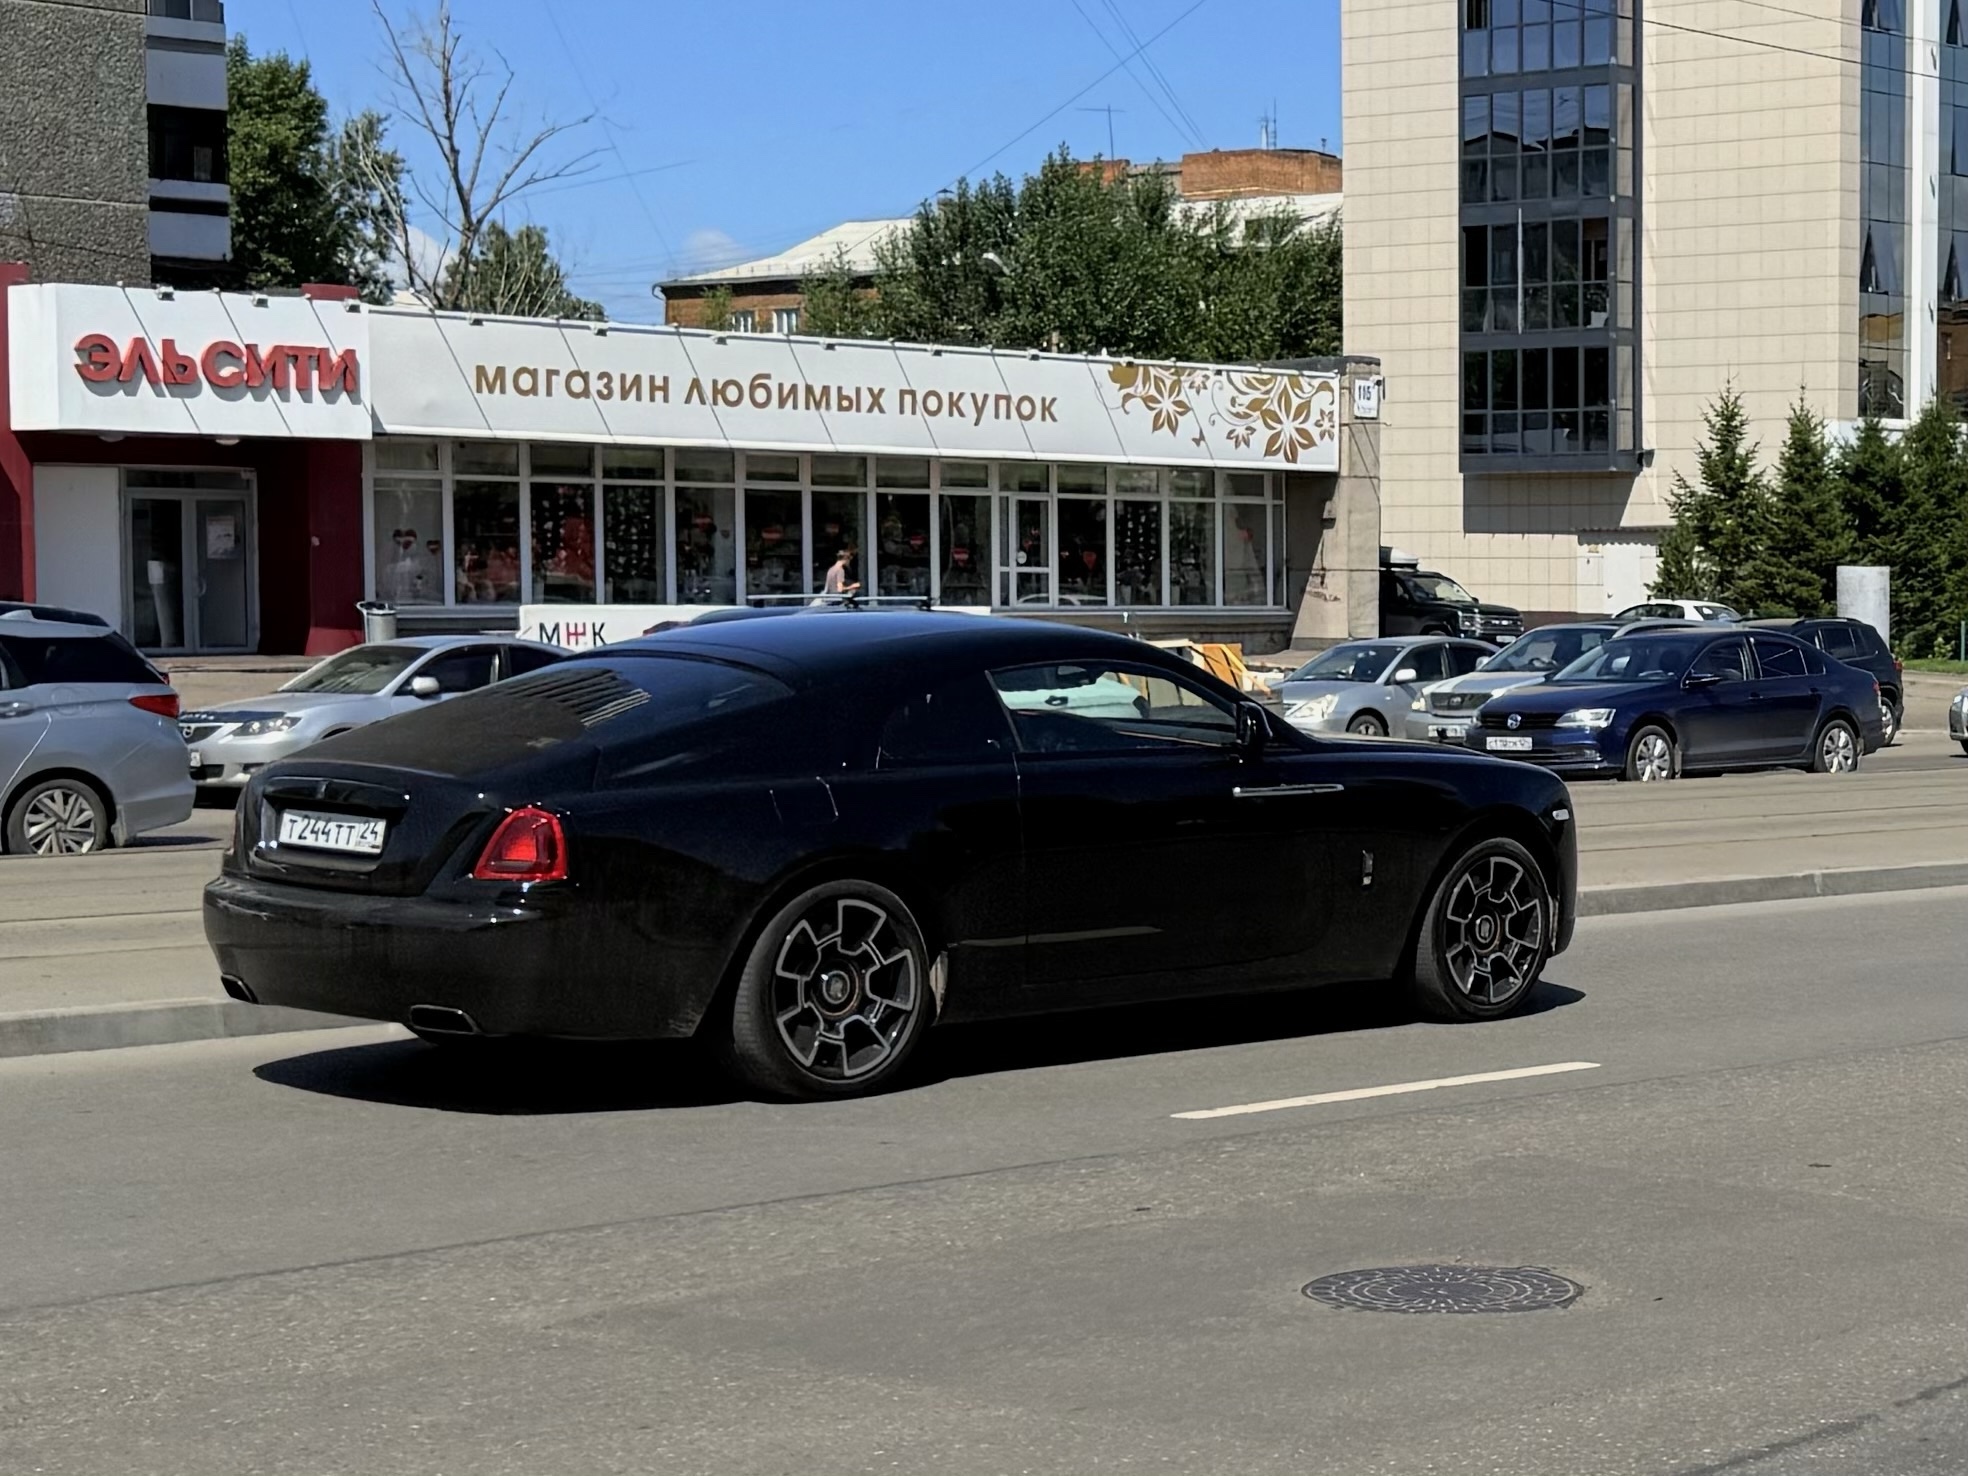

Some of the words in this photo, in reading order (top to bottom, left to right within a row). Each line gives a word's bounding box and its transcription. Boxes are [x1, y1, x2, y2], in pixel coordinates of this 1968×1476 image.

[475, 364, 670, 404] магазин
[684, 373, 887, 414] любимых
[899, 388, 1058, 427] покупок
